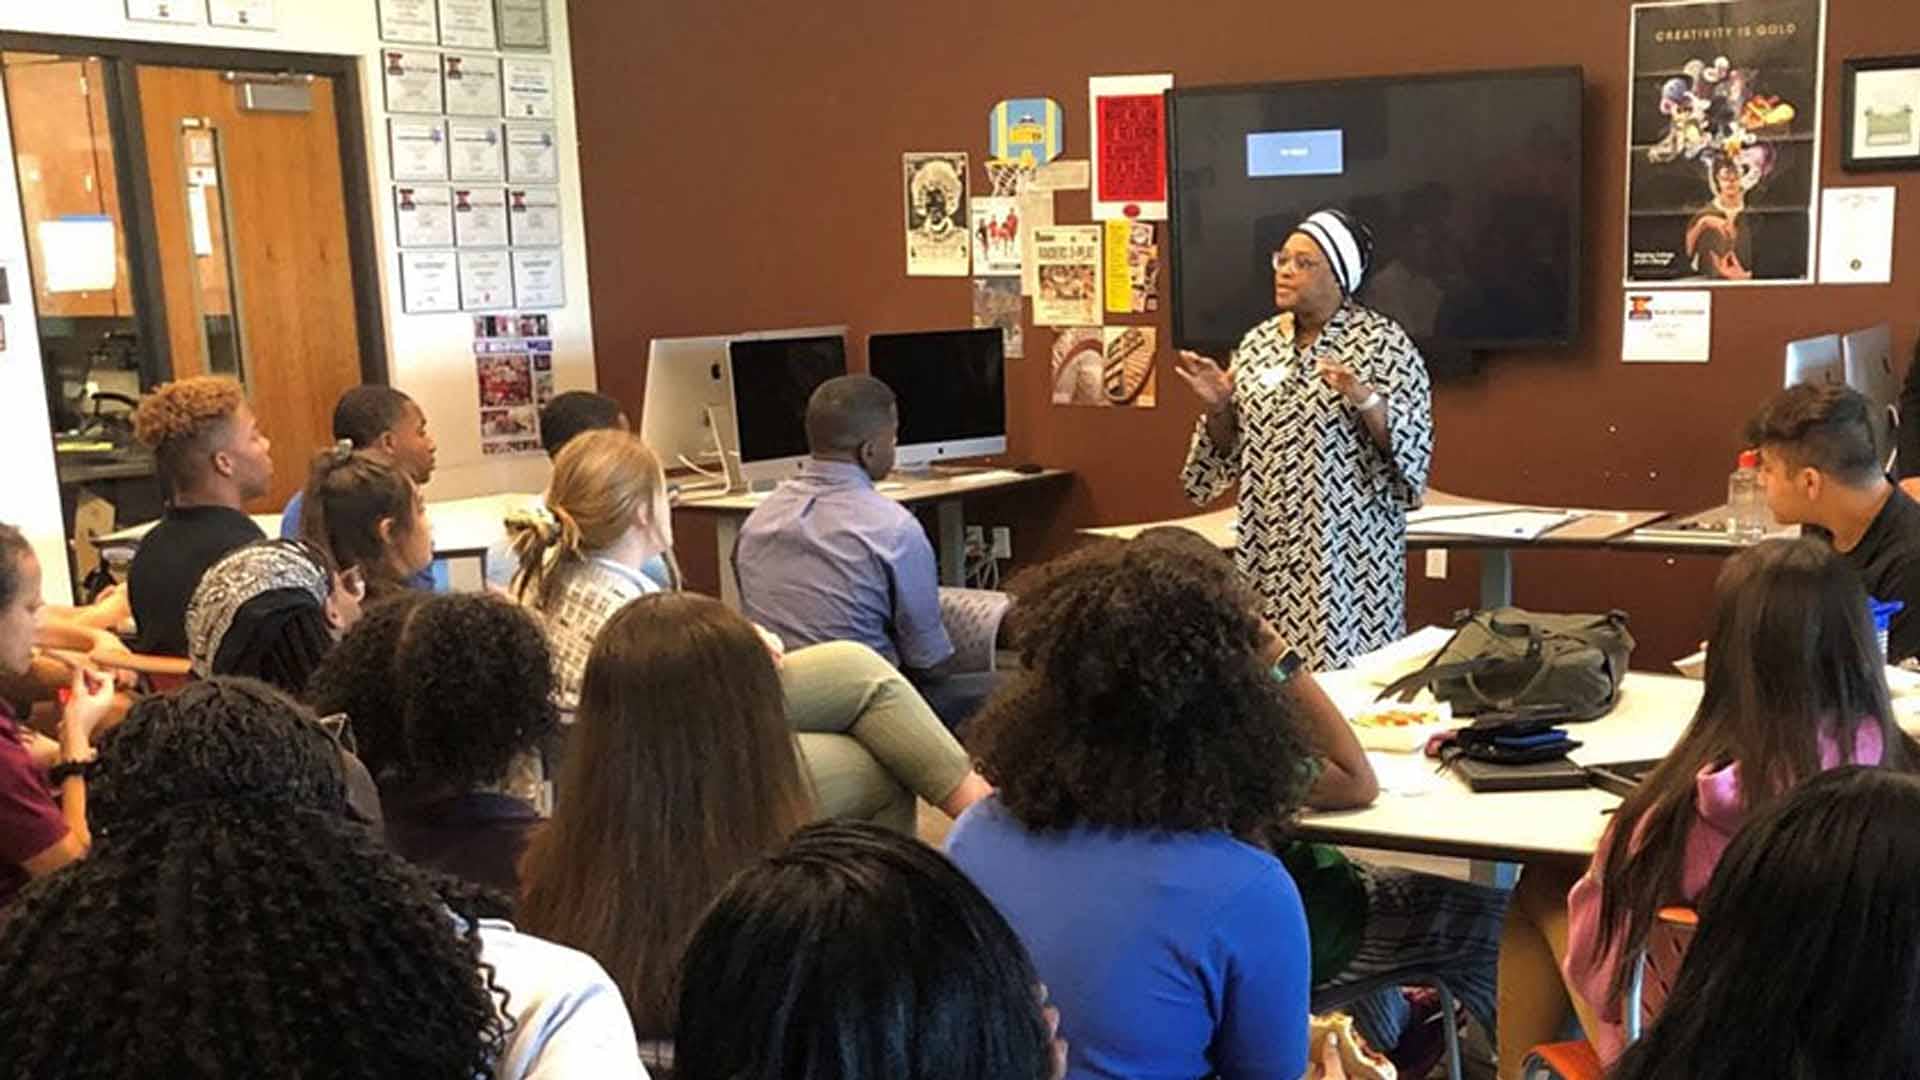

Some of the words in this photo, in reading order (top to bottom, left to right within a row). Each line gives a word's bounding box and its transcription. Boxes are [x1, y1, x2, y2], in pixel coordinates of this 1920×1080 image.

[1655, 26, 1732, 42] CREATIVITY
[1737, 26, 1751, 38] IS
[1755, 23, 1796, 37] GOLD
